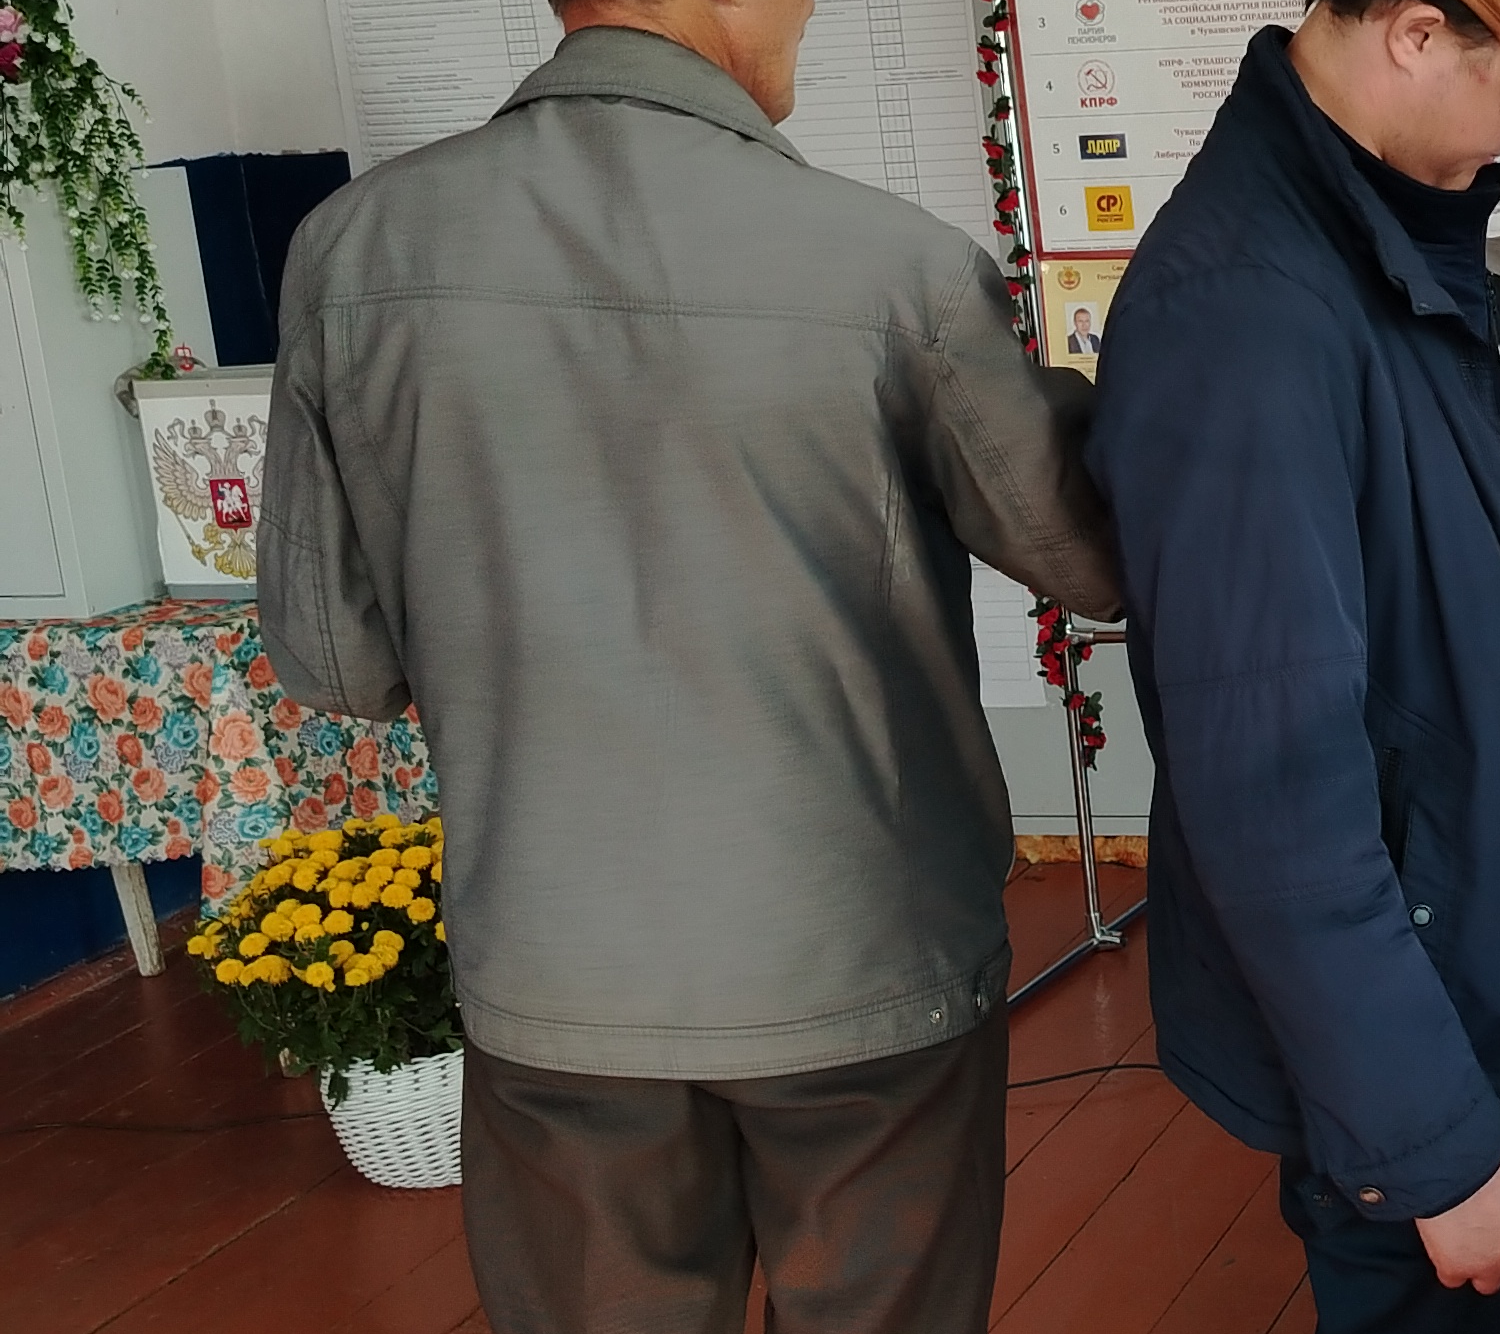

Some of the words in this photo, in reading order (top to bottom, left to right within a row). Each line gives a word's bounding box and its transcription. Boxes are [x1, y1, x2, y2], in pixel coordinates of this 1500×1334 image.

[1038, 17, 1046, 28] 3
[1067, 35, 1116, 44] ПЕНСИОНЕРОВ
[1046, 80, 1053, 91] 4
[1080, 97, 1118, 108] КПРФ
[1053, 143, 1060, 154] 5
[1087, 139, 1121, 155] ЛДПР
[1059, 205, 1067, 216] 6
